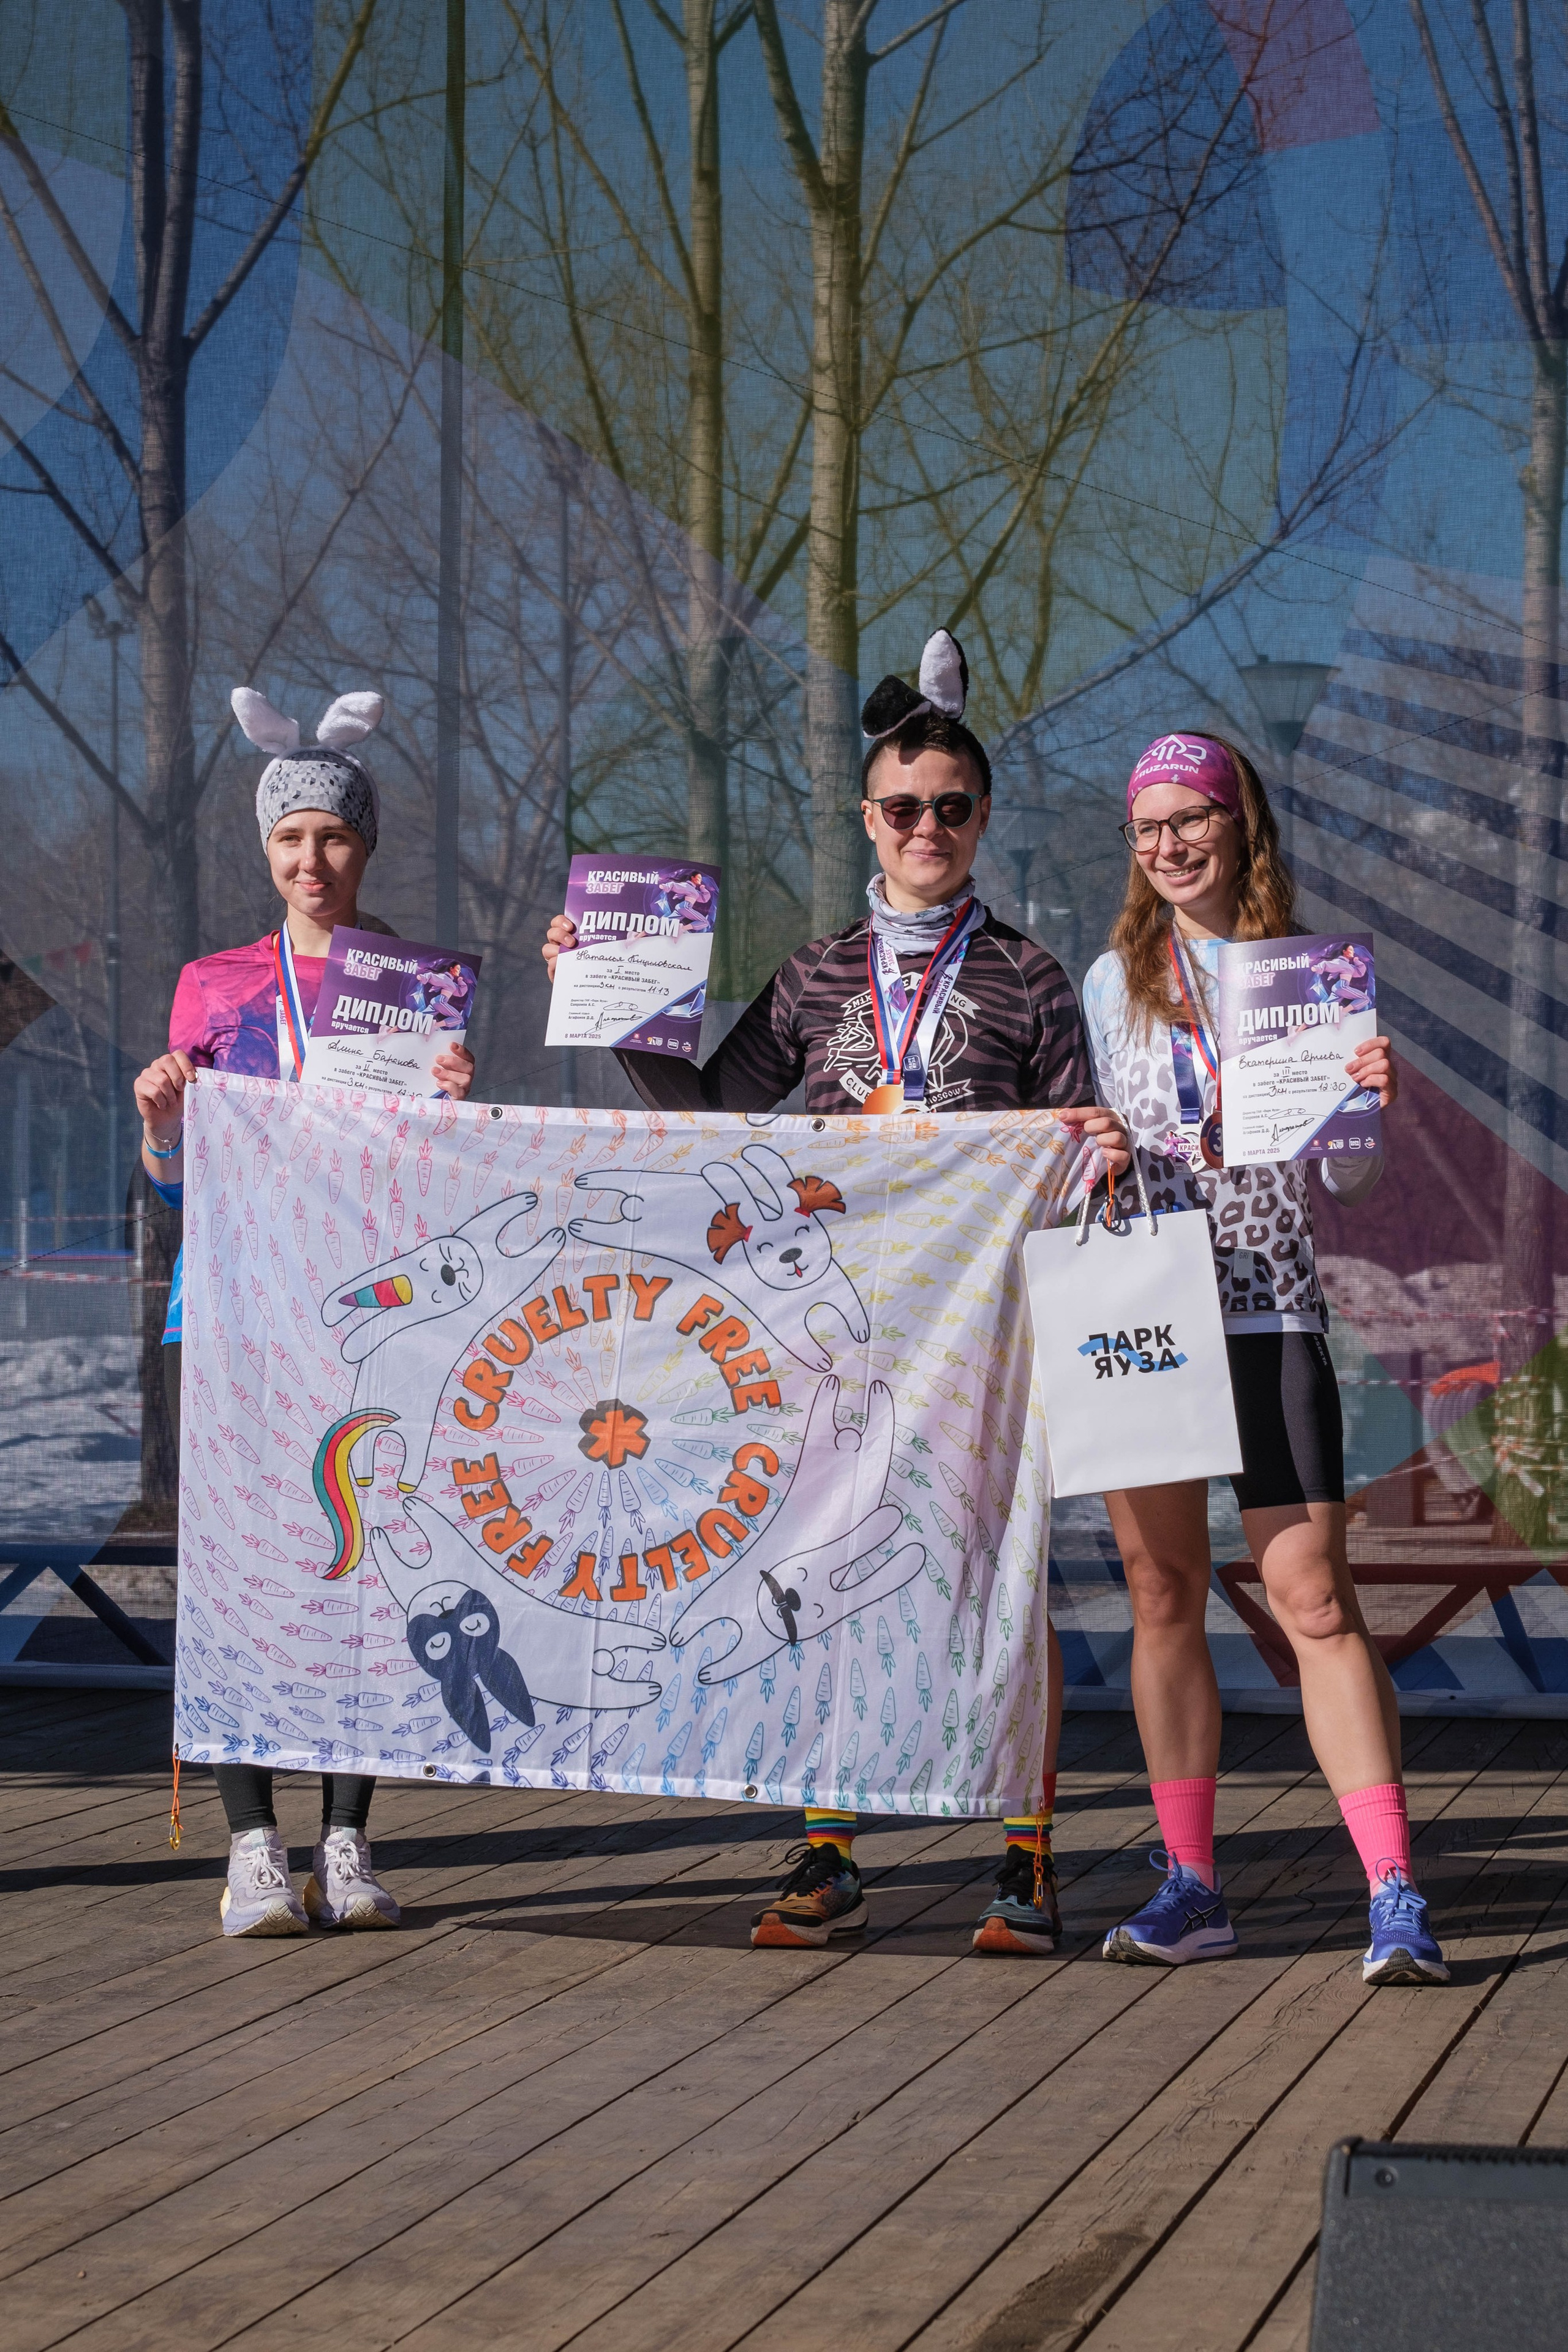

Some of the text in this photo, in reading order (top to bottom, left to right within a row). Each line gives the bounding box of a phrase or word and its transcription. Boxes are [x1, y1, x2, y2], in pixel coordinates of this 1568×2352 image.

[587, 870, 659, 885] КРАСИВЫЙ
[586, 882, 624, 894] ЗАБЕГ
[579, 911, 680, 937] ДИПЛОМ
[347, 948, 418, 974] КРАСИВЫЙ
[1237, 953, 1310, 973] КРАСИВЫЙ
[344, 962, 382, 981] ЗАБЕГ
[1239, 972, 1275, 989] ЗАБЕГ
[648, 986, 669, 995] 11:13
[932, 978, 951, 1014] КРАСИВЫЙ
[332, 995, 433, 1035] ДИПЛОМ
[1237, 1002, 1340, 1036] ДИПЛОМ
[331, 1021, 369, 1035] вручается
[1239, 1034, 1278, 1045] вручается
[1239, 1055, 1297, 1069] Екатерина
[356, 1072, 387, 1082] «КРАСИВЫЙ
[1319, 1082, 1346, 1091] 12:30
[1088, 1324, 1175, 1356] ПАРК
[454, 1274, 782, 1431] CRUELTY FREE
[1095, 1348, 1180, 1379] ЯУЗА
[452, 1442, 778, 1602] CRUELTY FREE
